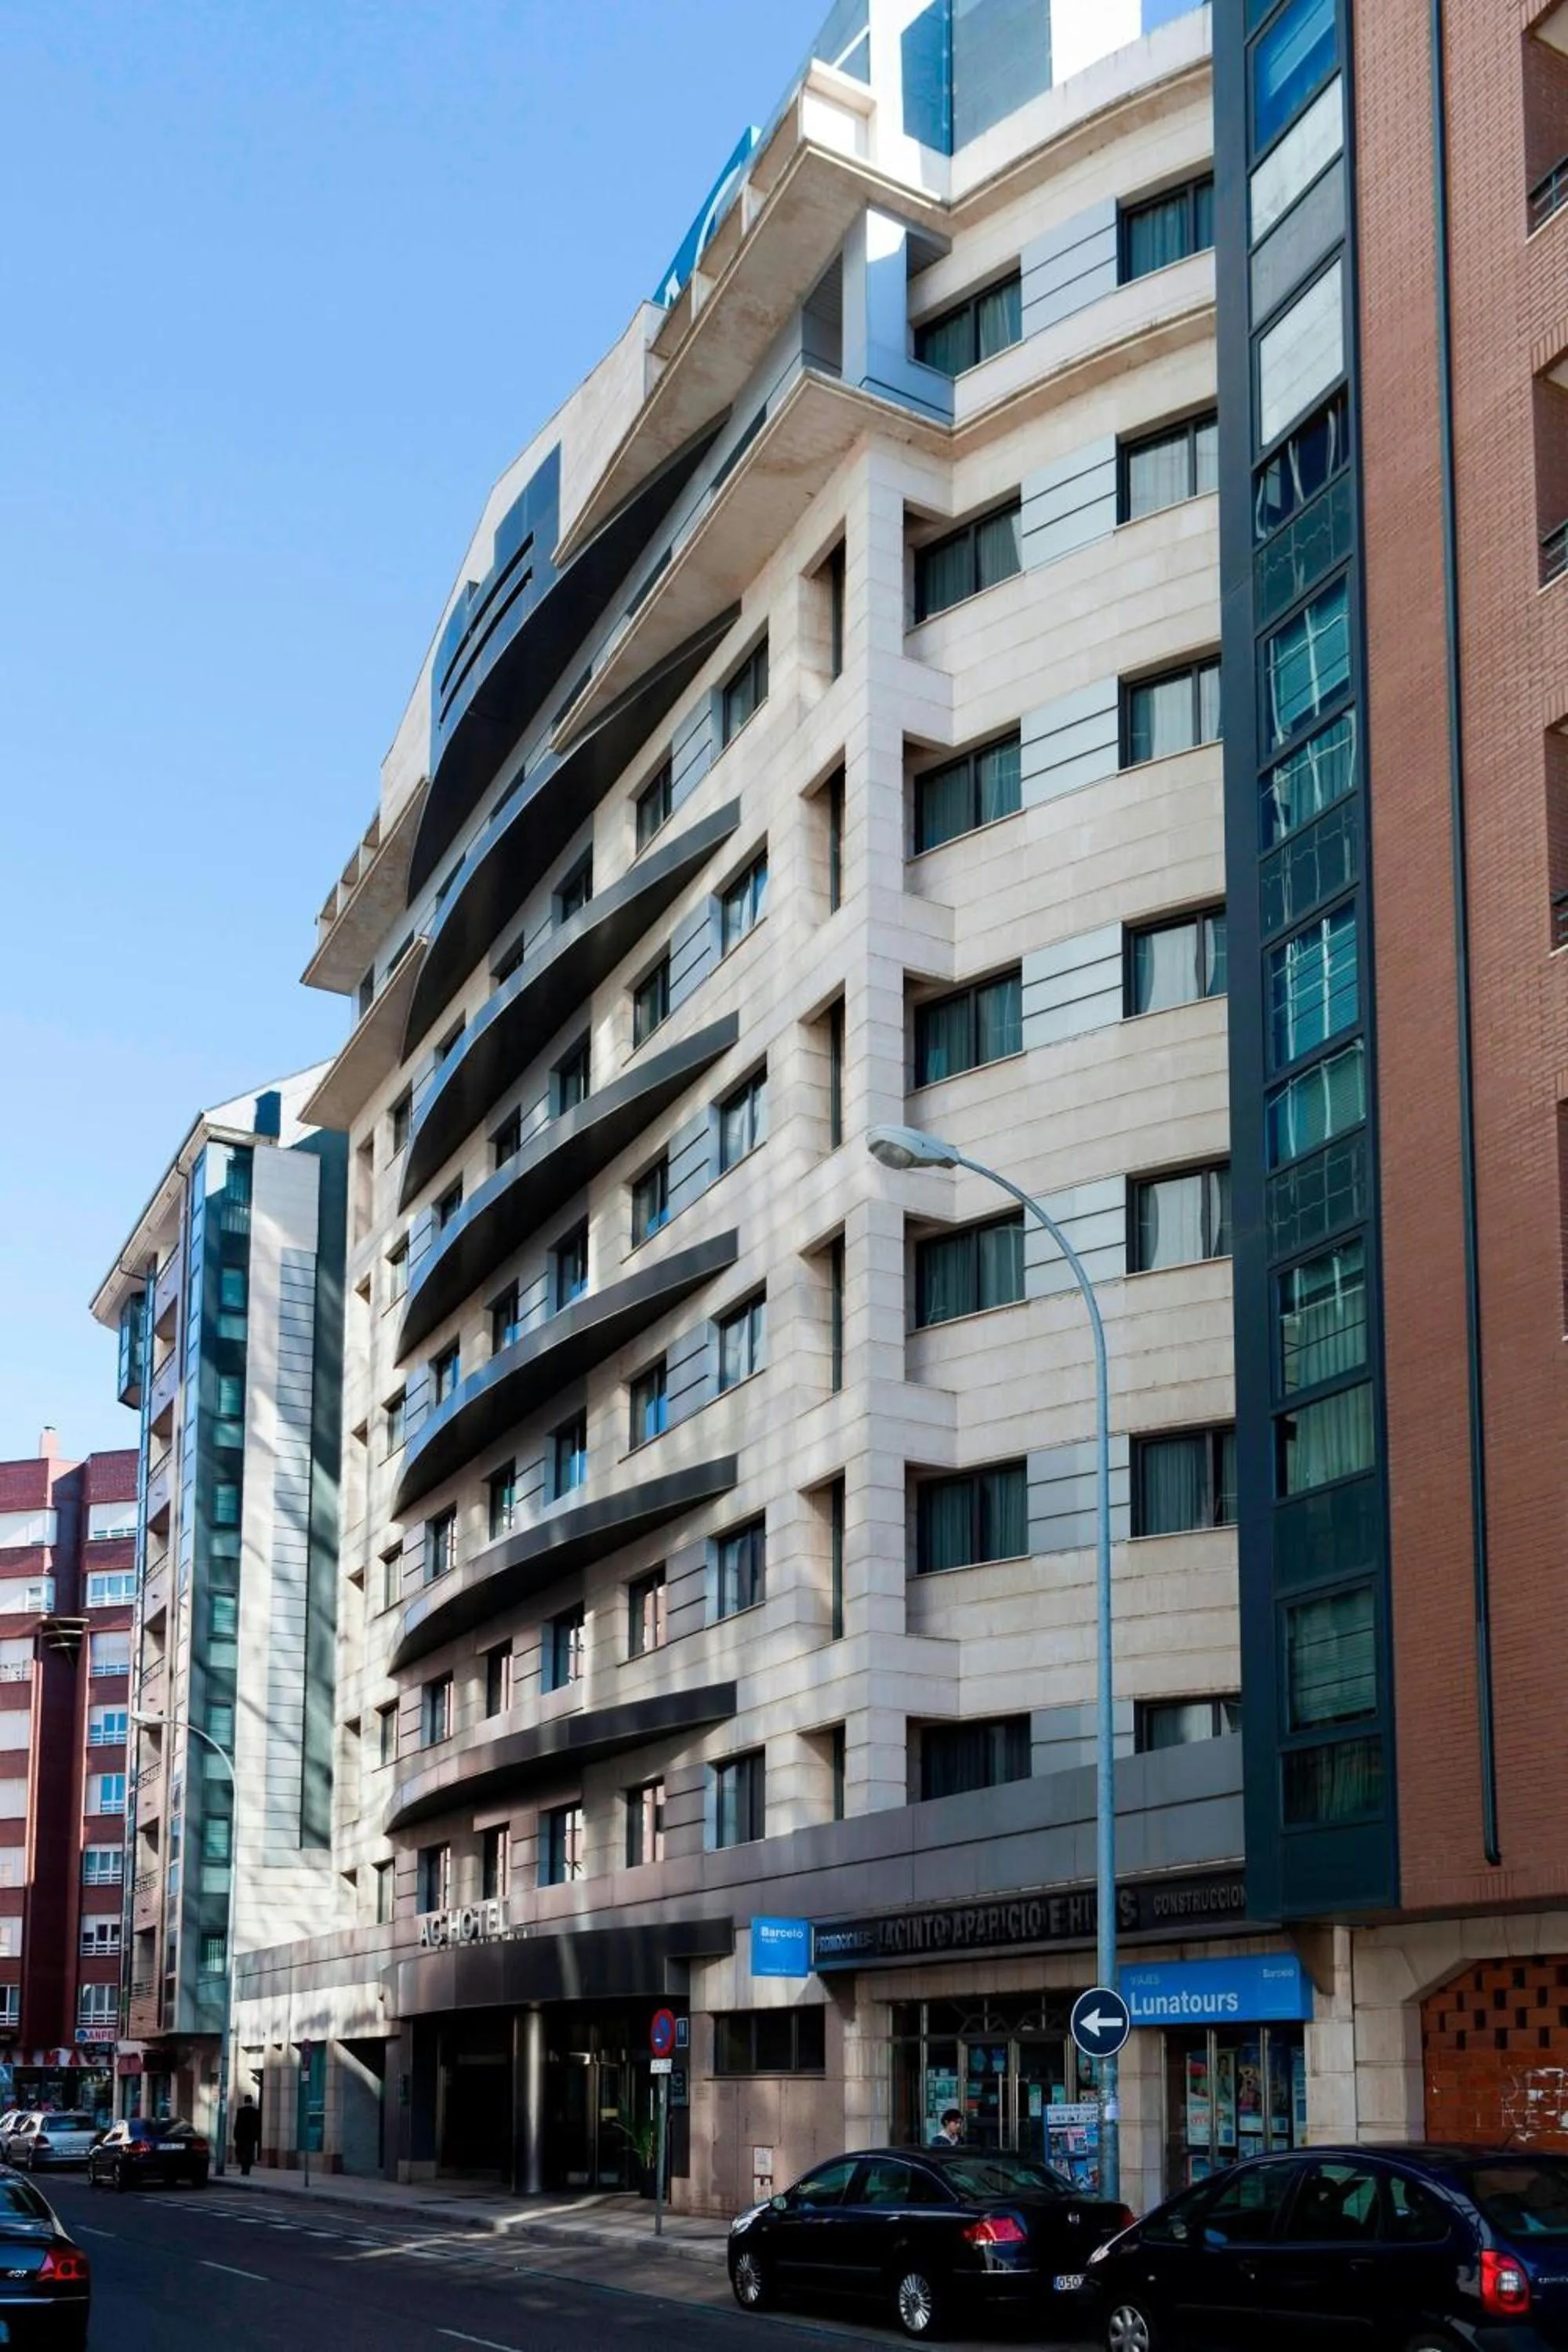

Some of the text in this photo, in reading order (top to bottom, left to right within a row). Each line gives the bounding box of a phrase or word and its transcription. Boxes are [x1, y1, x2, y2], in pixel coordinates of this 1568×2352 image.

[419, 1914, 444, 1947] AC
[448, 1900, 510, 1940] HOTEL
[877, 1914, 949, 1951] JACINTO
[952, 1901, 1042, 1944] APARICIO
[1049, 1898, 1064, 1934] E
[1069, 1889, 1138, 1934] HIS
[1131, 1990, 1239, 2016] Lunatours
